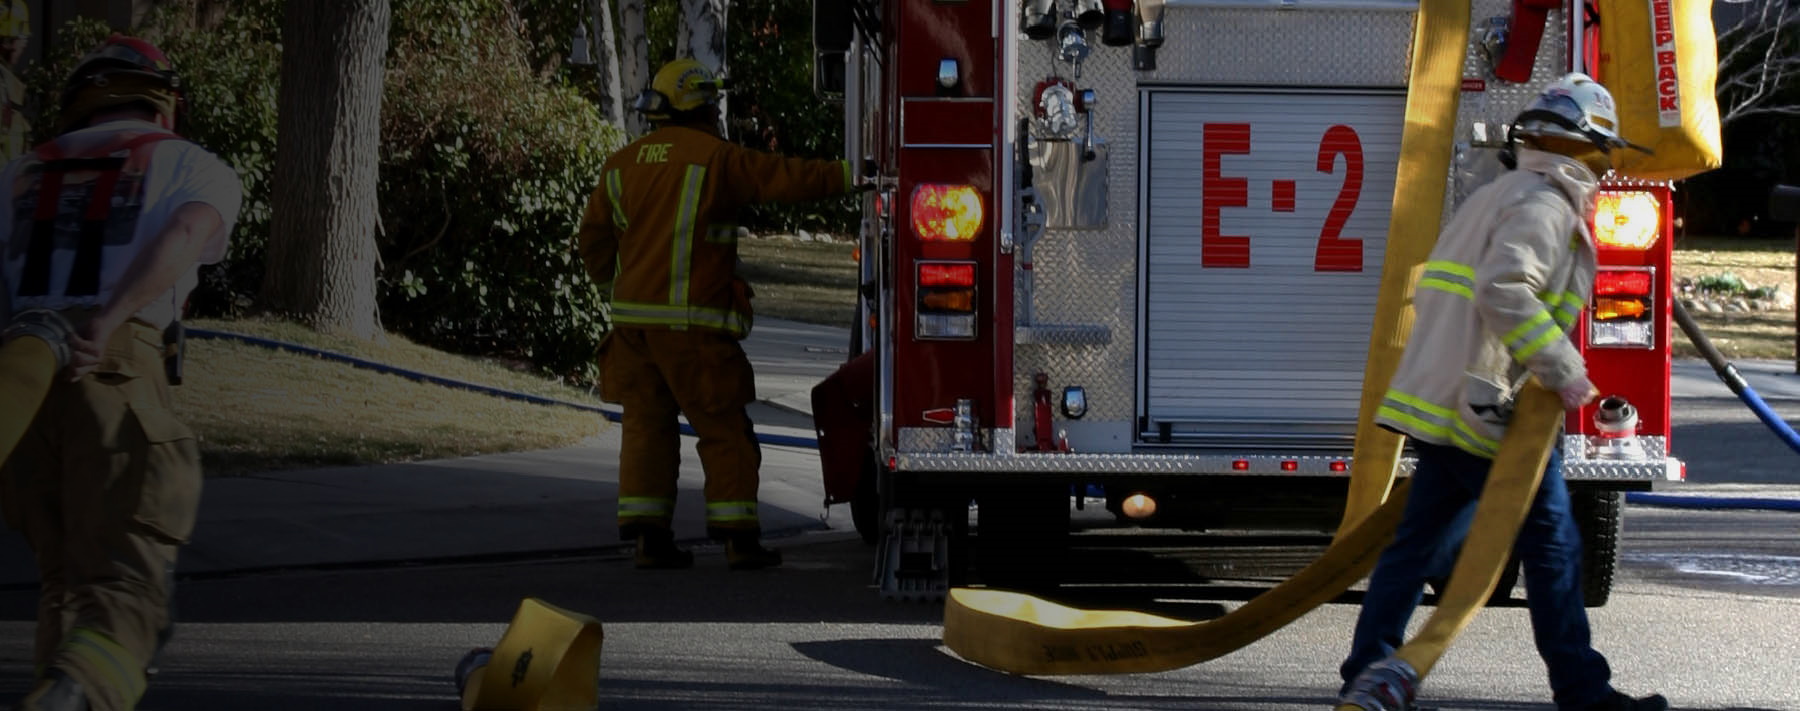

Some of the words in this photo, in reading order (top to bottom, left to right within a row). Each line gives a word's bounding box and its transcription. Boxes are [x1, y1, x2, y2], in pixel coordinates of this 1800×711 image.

[1653, 0, 1673, 47] EEP
[1657, 51, 1677, 111] BACK
[636, 143, 673, 164] FIRE
